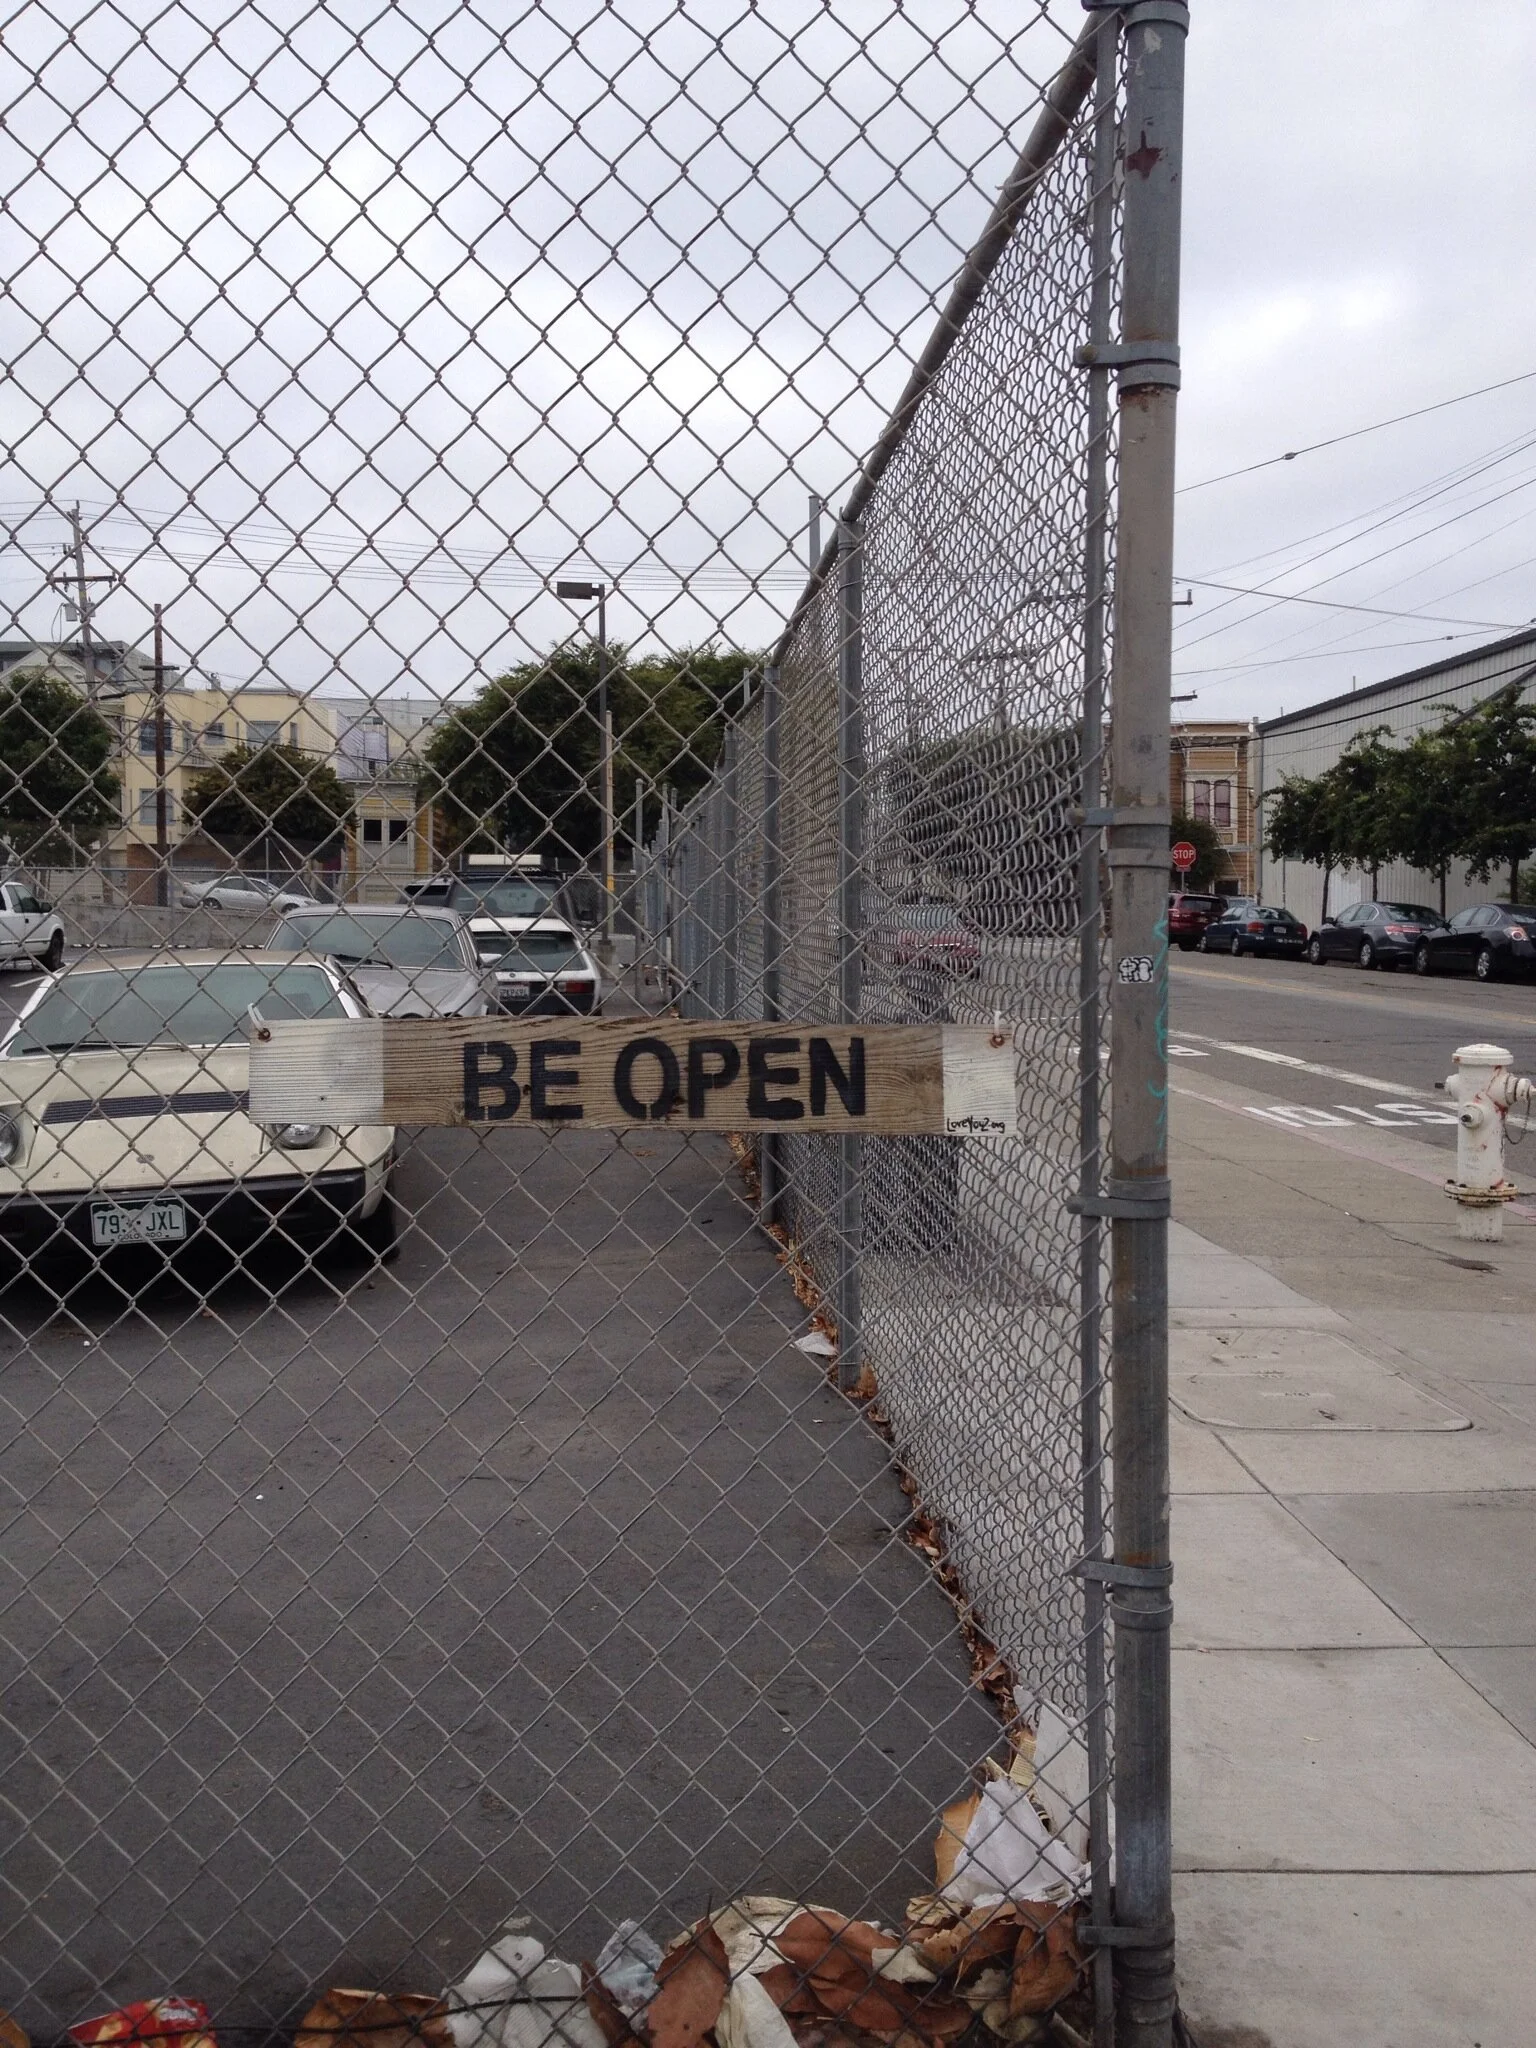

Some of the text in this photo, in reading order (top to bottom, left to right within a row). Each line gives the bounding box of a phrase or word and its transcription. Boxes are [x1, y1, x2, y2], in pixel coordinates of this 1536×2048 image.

[1173, 849, 1195, 859] STOP
[463, 1037, 867, 1121] BE OPEN
[96, 1211, 180, 1236] 79 JXL
[118, 1231, 163, 1240] COLOADO
